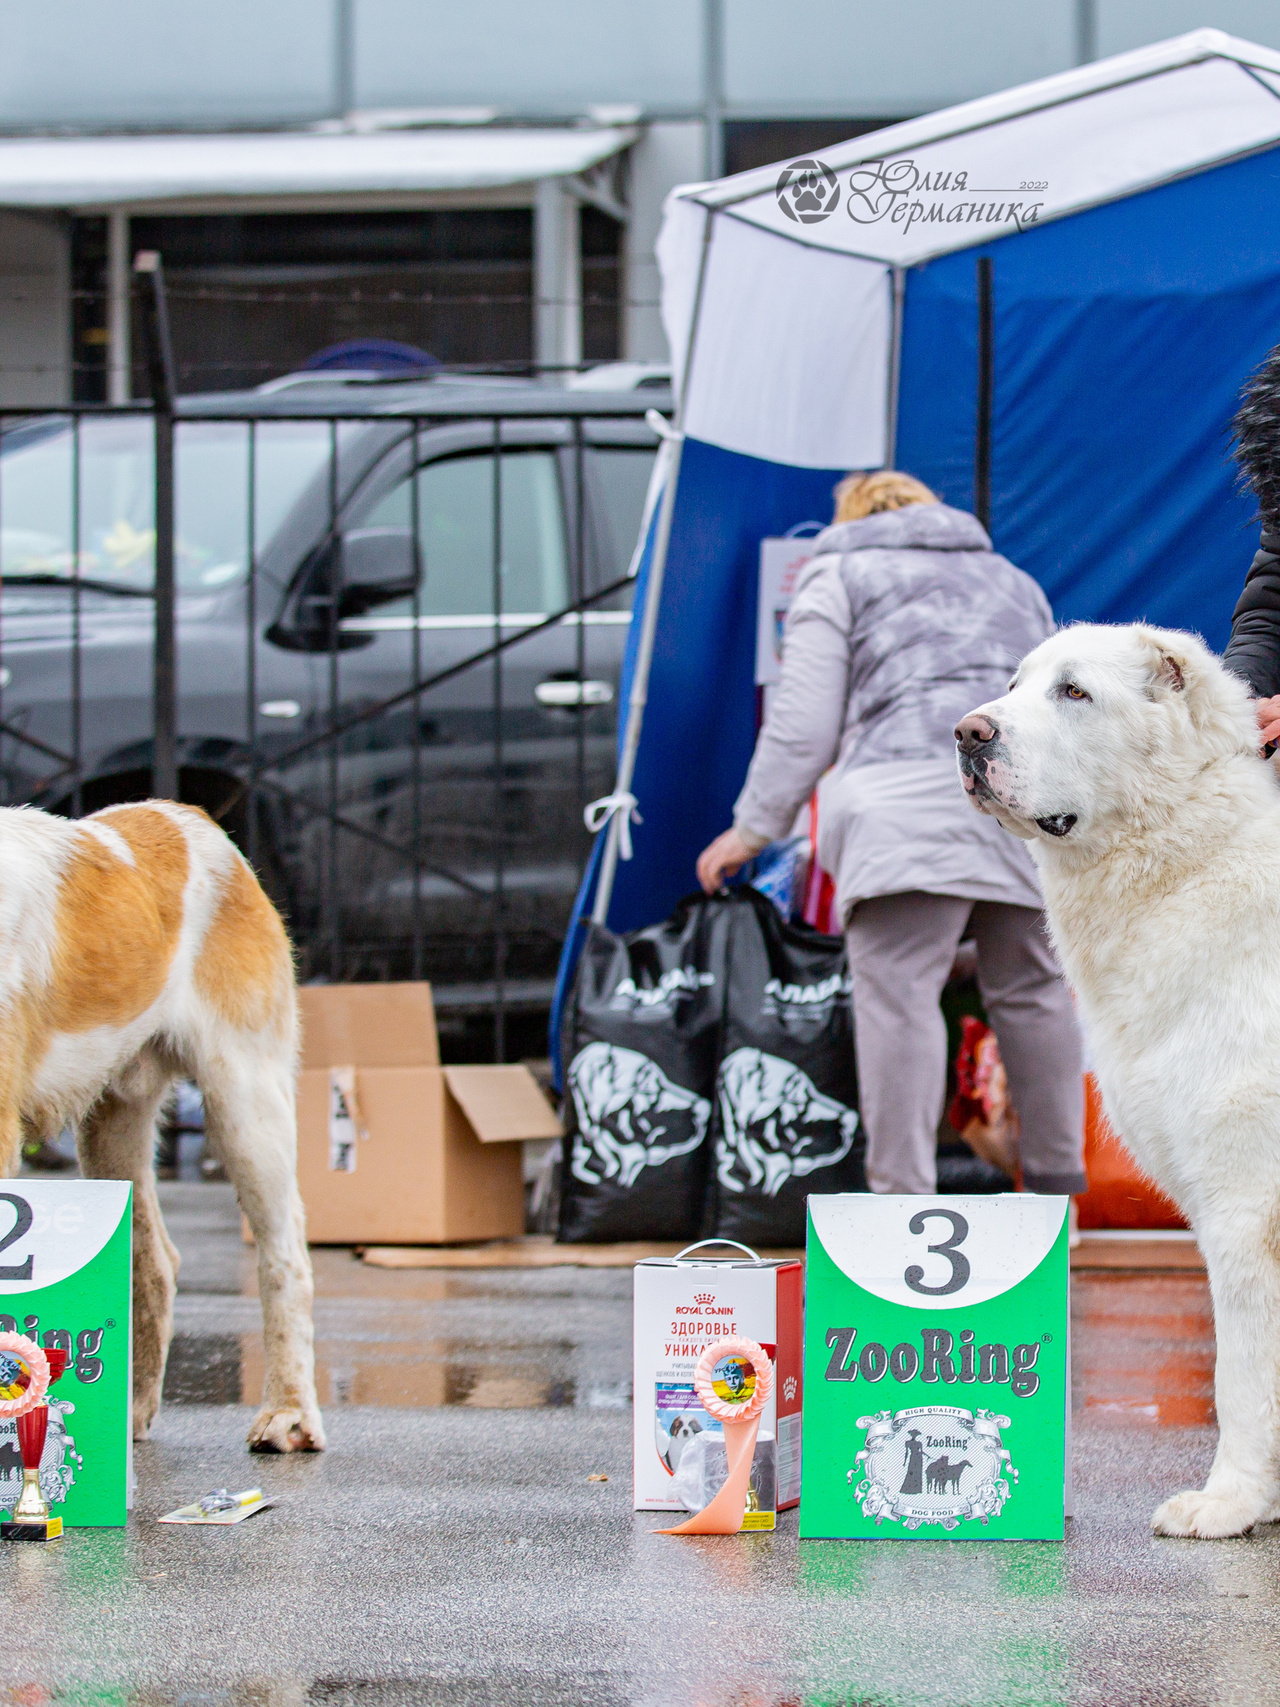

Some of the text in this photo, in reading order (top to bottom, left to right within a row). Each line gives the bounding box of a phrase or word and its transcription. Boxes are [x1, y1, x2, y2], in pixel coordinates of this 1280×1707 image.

[904, 1208, 971, 1296] 3
[676, 1306, 733, 1315] ROYAL CANIN
[671, 1321, 737, 1336] ЗДОРОВЬЕ
[665, 1344, 708, 1357] УНИКА
[824, 1327, 1040, 1398] ZooRing
[905, 1407, 963, 1415] HIGH QUALITY
[926, 1435, 968, 1451] ZooRing
